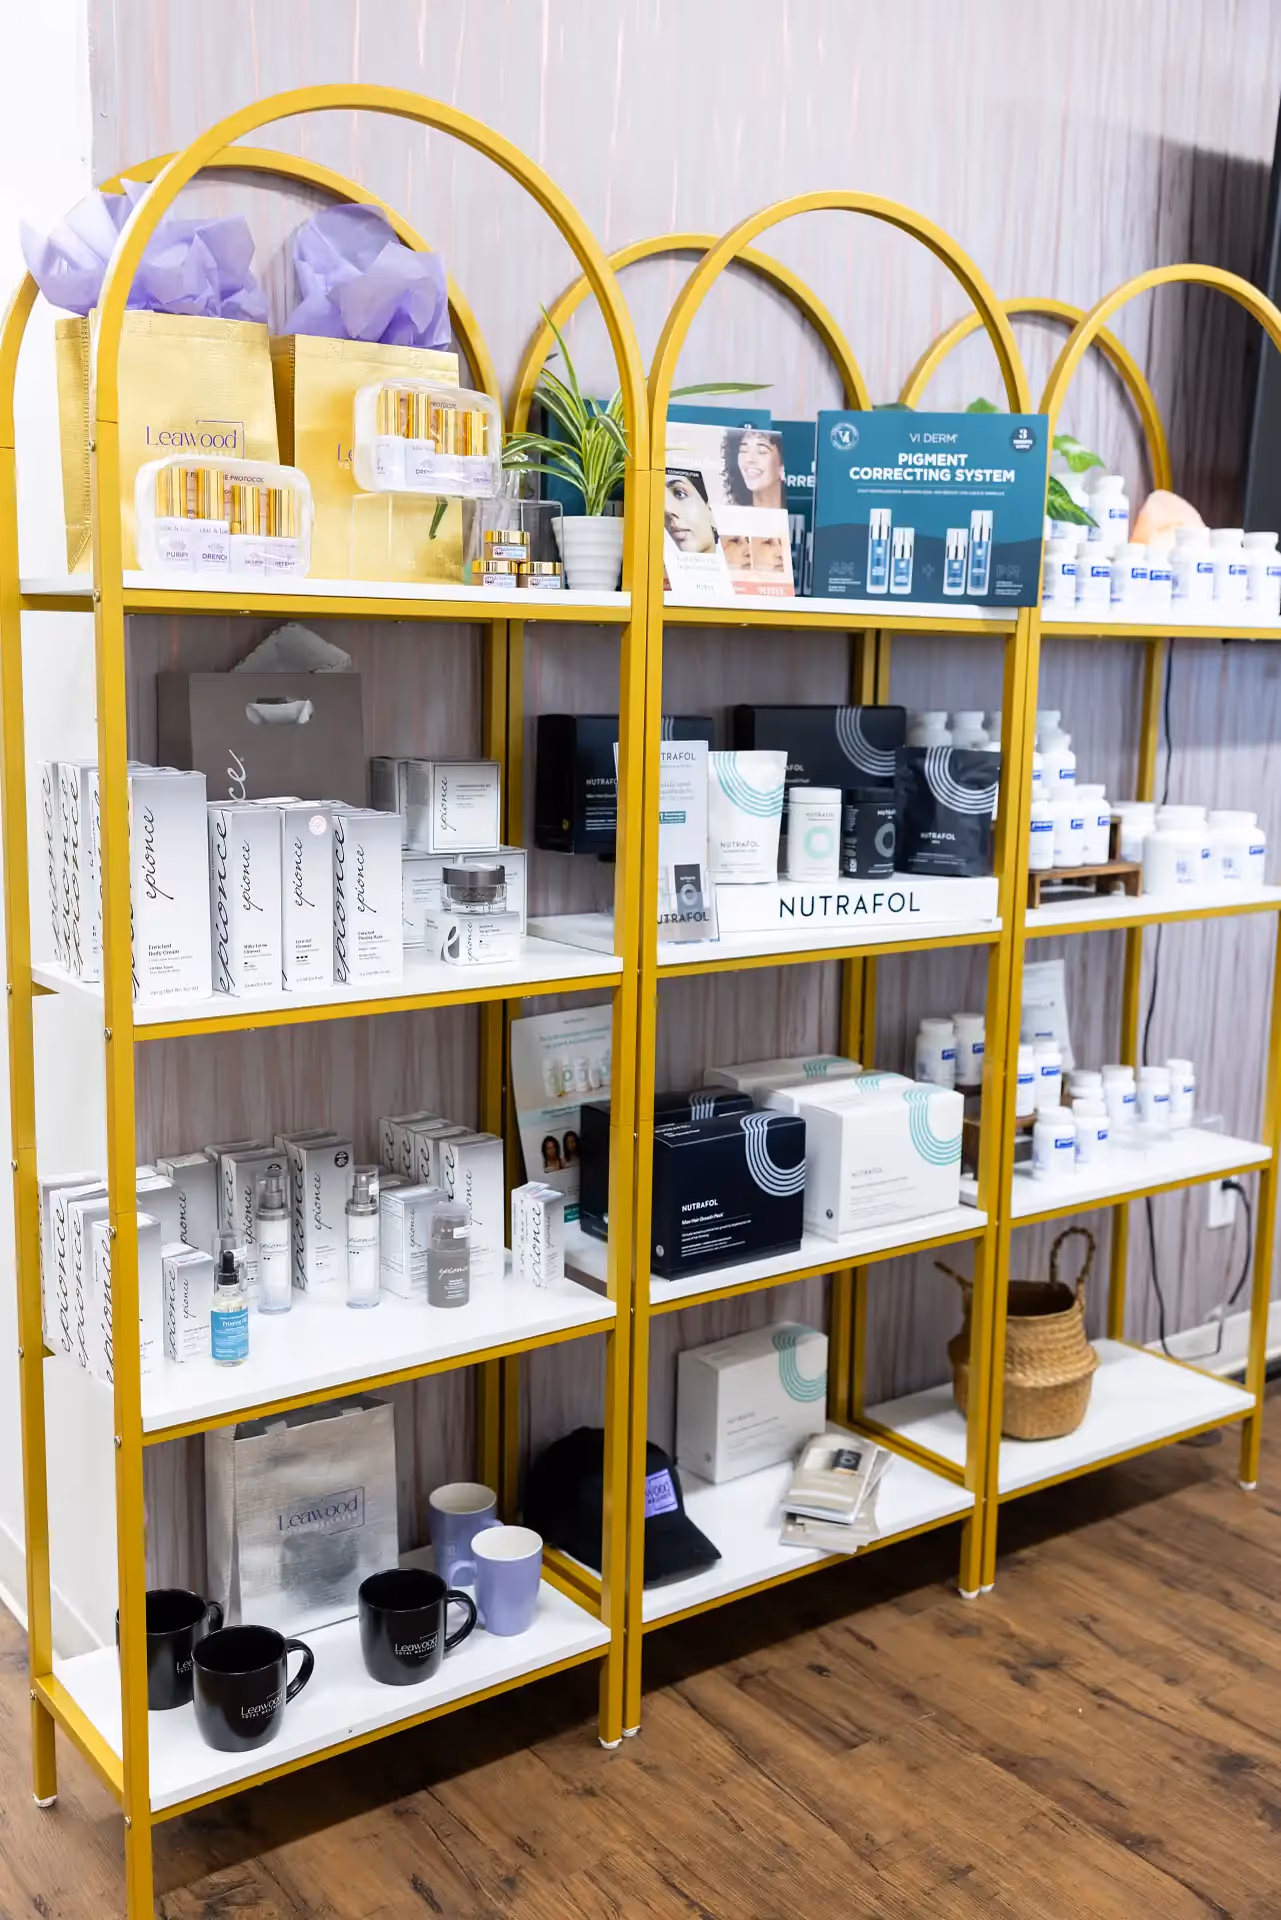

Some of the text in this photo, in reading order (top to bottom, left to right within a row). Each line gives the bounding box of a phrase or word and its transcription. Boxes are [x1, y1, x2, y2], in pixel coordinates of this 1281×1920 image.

[146, 425, 237, 449] Leawood
[909, 433, 921, 443] VI
[1018, 428, 1028, 439] 3
[667, 469, 700, 478] COSMOPOLITAN
[898, 453, 968, 467] PIGMENT
[230, 474, 265, 483] PROTOCOL
[849, 467, 1015, 483] CORRECTING SYSTEM
[660, 752, 696, 761] TRAFOL
[784, 764, 805, 772] AFOL
[143, 805, 174, 900] epionce
[720, 840, 760, 849] NUTRAFOL
[240, 839, 264, 912] epionce
[292, 836, 315, 907] epionce
[355, 843, 377, 913] epionce
[215, 809, 236, 991] epionce
[333, 816, 351, 982] epionce
[779, 892, 920, 919] NUTRAFOL
[657, 911, 710, 925] UTRAFOL
[312, 1172, 332, 1230] epionce
[681, 1199, 719, 1213] NUTRAFOL
[180, 1190, 199, 1250] pionce
[530, 1203, 541, 1288] epionce
[56, 1197, 74, 1352] epionce
[74, 1208, 90, 1369] epionce
[182, 1278, 197, 1319] epionce
[278, 1492, 359, 1531] Leawood
[395, 1633, 438, 1652] Leawood
[241, 1689, 283, 1716] Leawood
